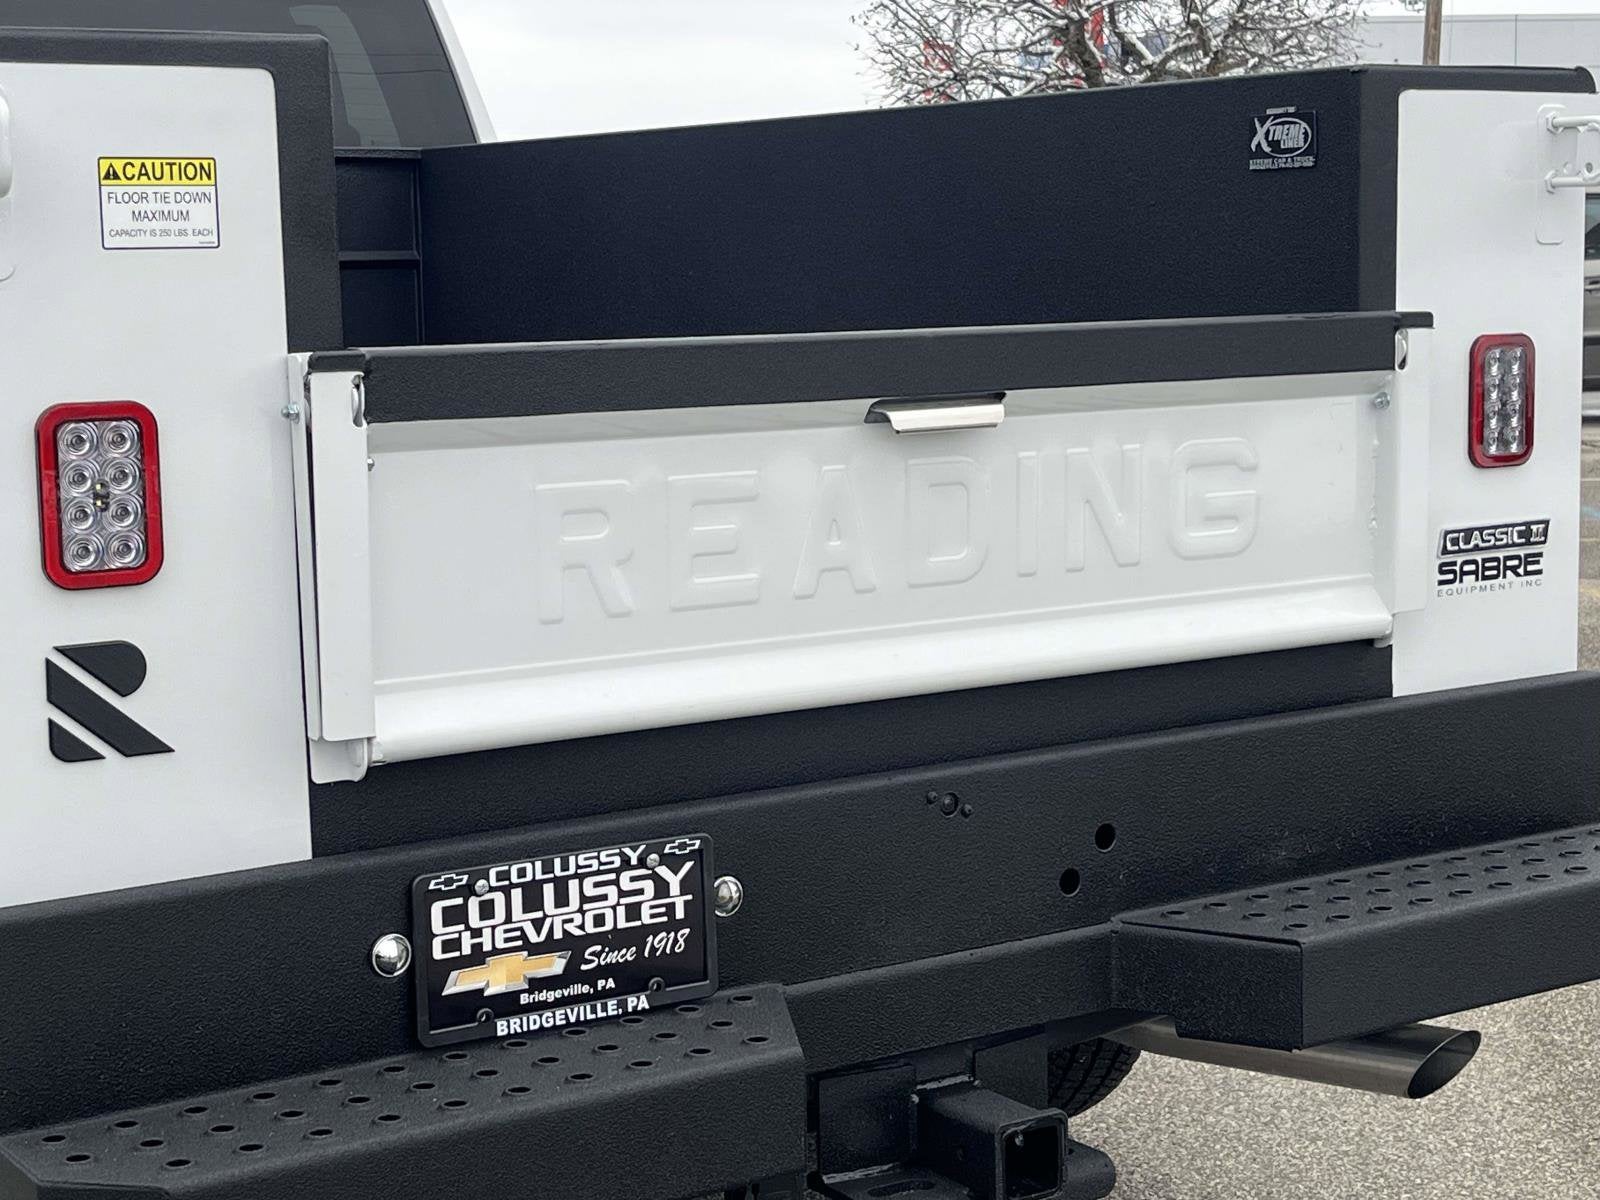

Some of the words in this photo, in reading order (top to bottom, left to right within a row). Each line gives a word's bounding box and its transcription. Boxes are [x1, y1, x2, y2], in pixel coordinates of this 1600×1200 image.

[1251, 116, 1305, 152] XTREME
[122, 161, 212, 181] CAUTION
[107, 191, 149, 204] FLOOR
[152, 191, 171, 204] TIE
[174, 191, 212, 204] DOWN
[109, 229, 147, 238] CAPACITY
[149, 229, 157, 237] IS
[159, 229, 172, 237] 250
[192, 228, 213, 237] EACH
[131, 210, 190, 222] MAXIMUM
[532, 436, 1259, 625] READING
[1446, 526, 1526, 551] CLASSIC
[1529, 523, 1546, 542] II
[1437, 551, 1543, 586] SABRE
[1437, 581, 1514, 598] EQUIPMENT
[1520, 578, 1543, 589] INC
[488, 844, 647, 888] COLUSSY
[430, 860, 695, 936] COLUSSY
[431, 893, 693, 961] CHEVROLET
[580, 944, 637, 971] Since
[643, 927, 691, 958] 1918
[519, 983, 594, 1005] Bridgeville,
[597, 977, 616, 991] PA
[496, 998, 623, 1037] BRIDGEVILLE,
[628, 994, 650, 1011] PA
